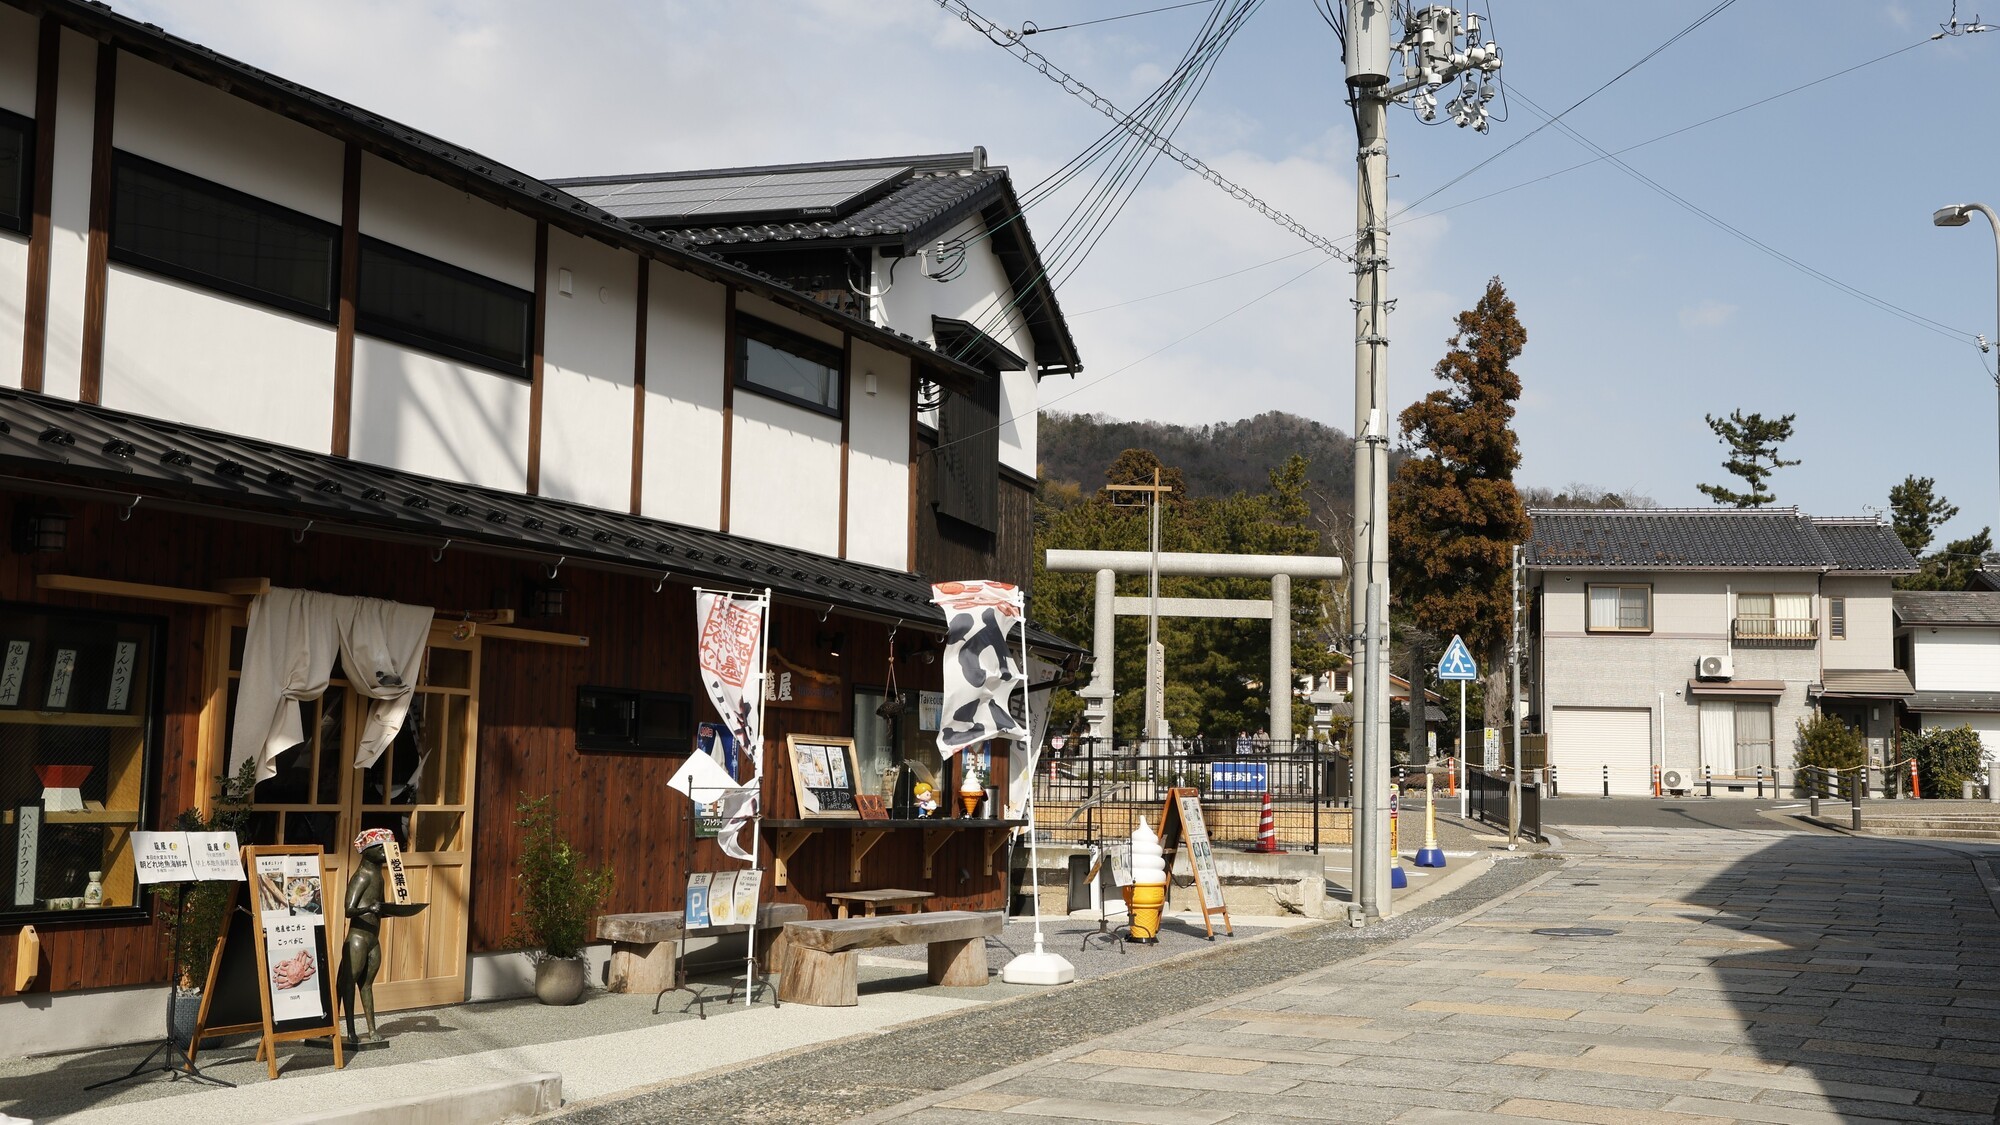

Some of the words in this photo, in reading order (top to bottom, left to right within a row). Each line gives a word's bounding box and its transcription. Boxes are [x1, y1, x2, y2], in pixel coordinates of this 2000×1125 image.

[111, 644, 130, 710] とんかつランチ
[1213, 771, 1252, 782] 横断歩道
[18, 813, 34, 897] ハンバーグランチ
[391, 858, 408, 901] 営業中
[691, 892, 702, 917] P
